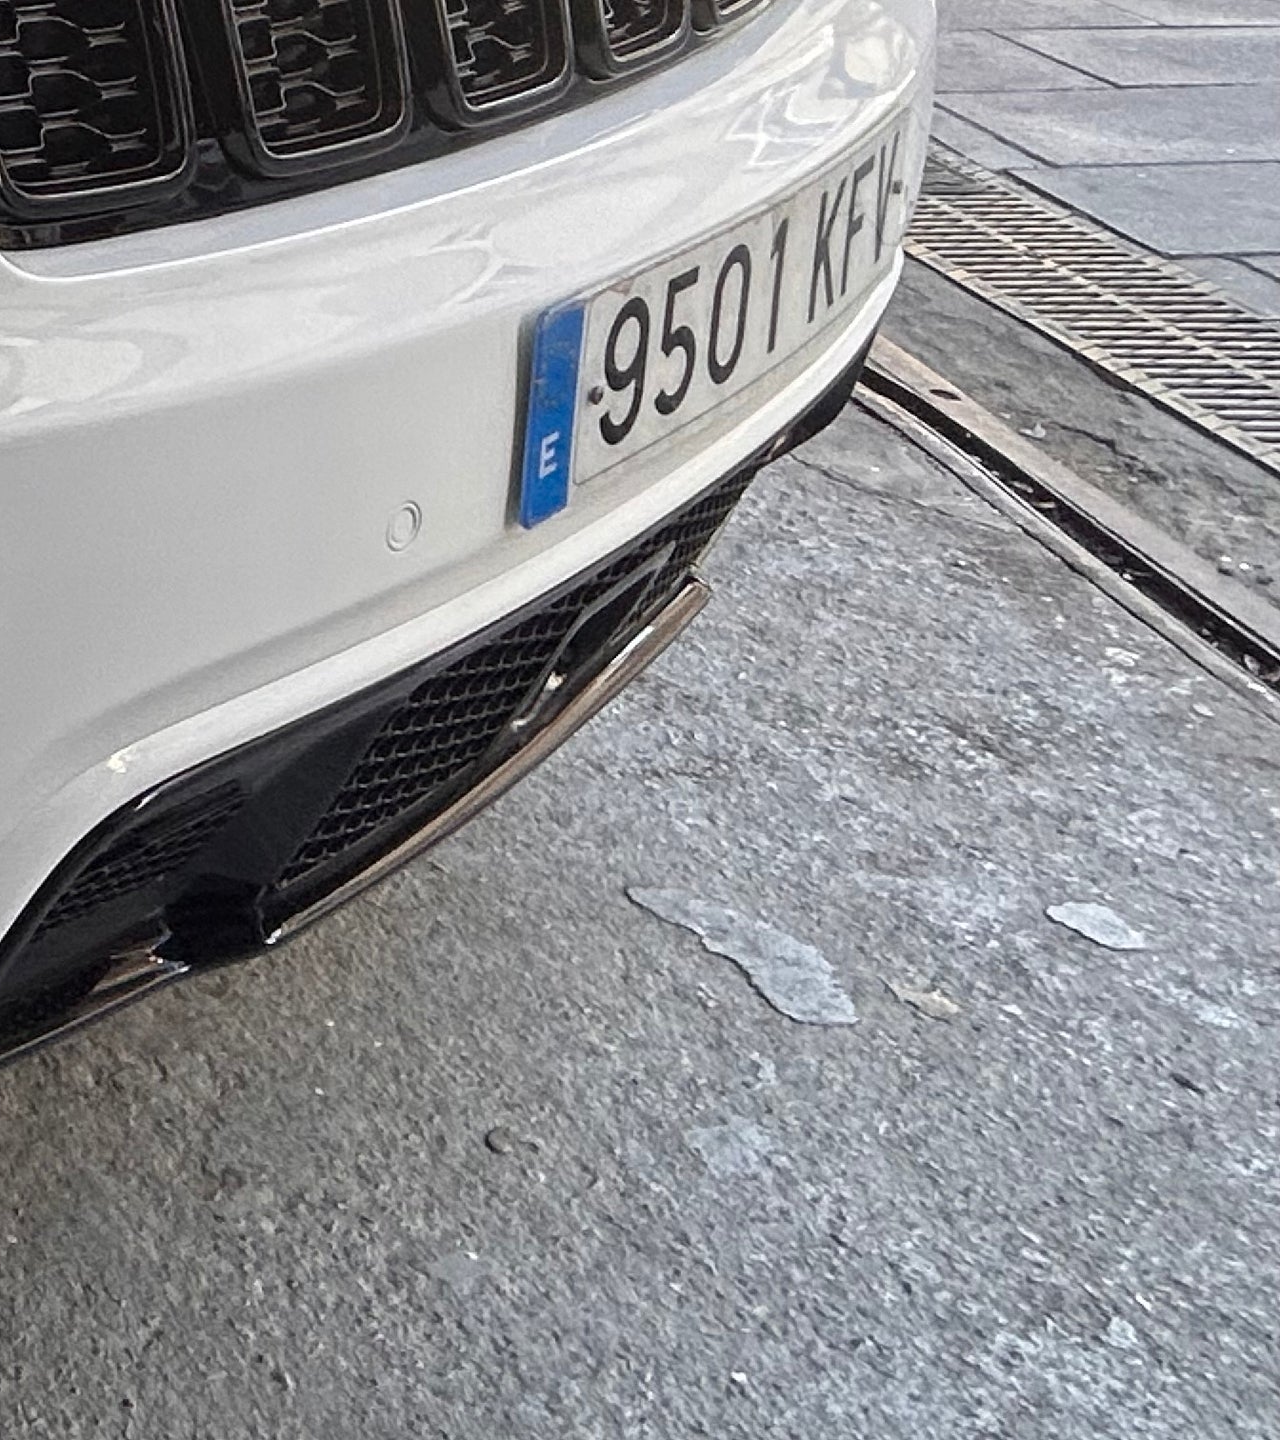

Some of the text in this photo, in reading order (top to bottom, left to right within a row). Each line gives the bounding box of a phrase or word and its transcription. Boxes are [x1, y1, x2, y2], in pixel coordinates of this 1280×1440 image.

[599, 131, 901, 445] 9501 KFV
[539, 431, 560, 479] E
